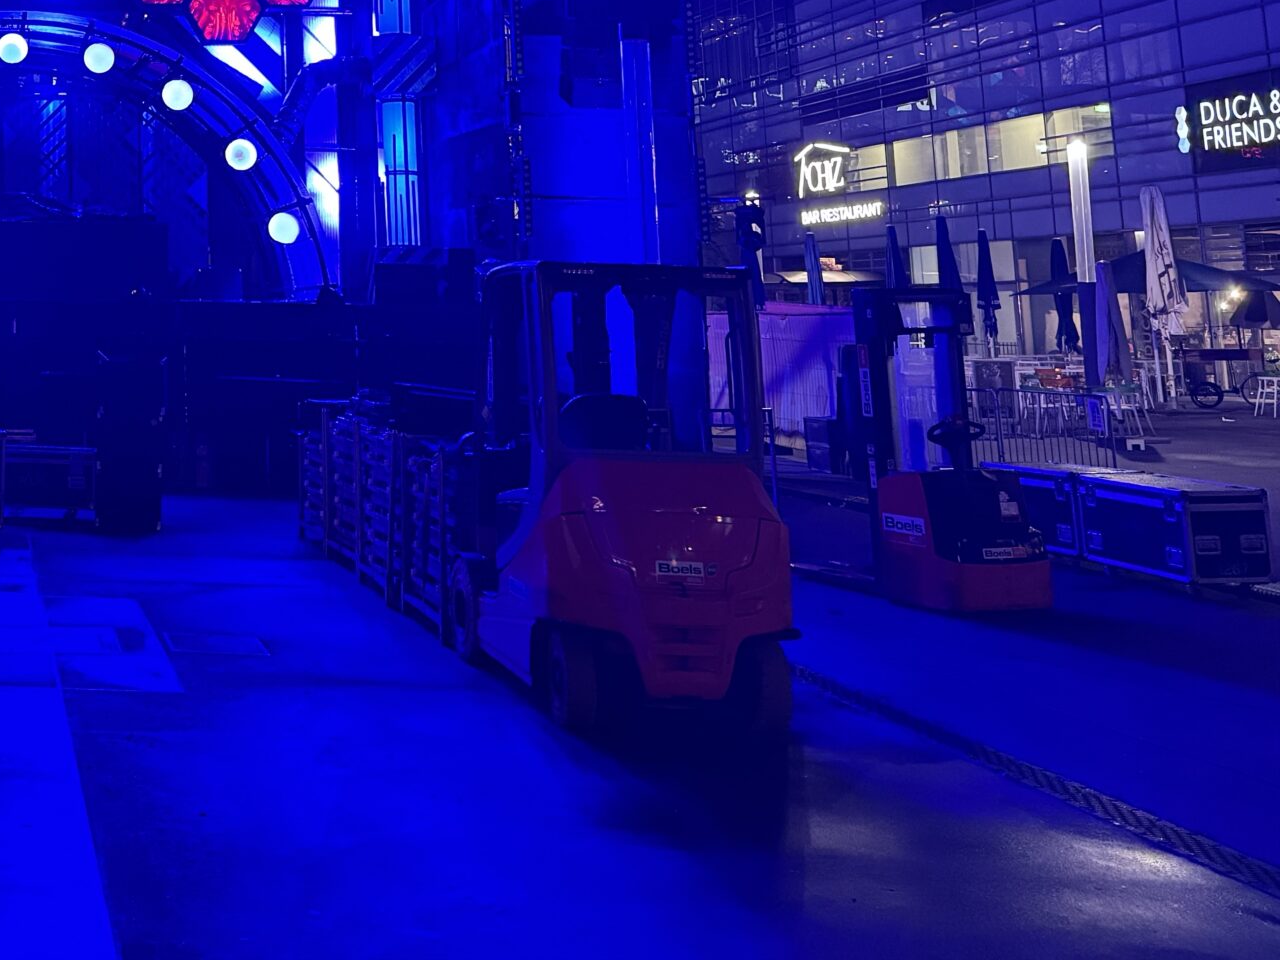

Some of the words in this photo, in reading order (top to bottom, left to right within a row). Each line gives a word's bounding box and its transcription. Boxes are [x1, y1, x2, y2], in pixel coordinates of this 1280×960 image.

[1200, 92, 1264, 125] DUCA
[1269, 89, 1280, 114] &
[801, 209, 821, 225] BAR
[821, 202, 882, 223] RESTAURANT
[862, 370, 871, 414] Boels
[885, 516, 923, 533] Boels
[658, 562, 702, 574] Boels
